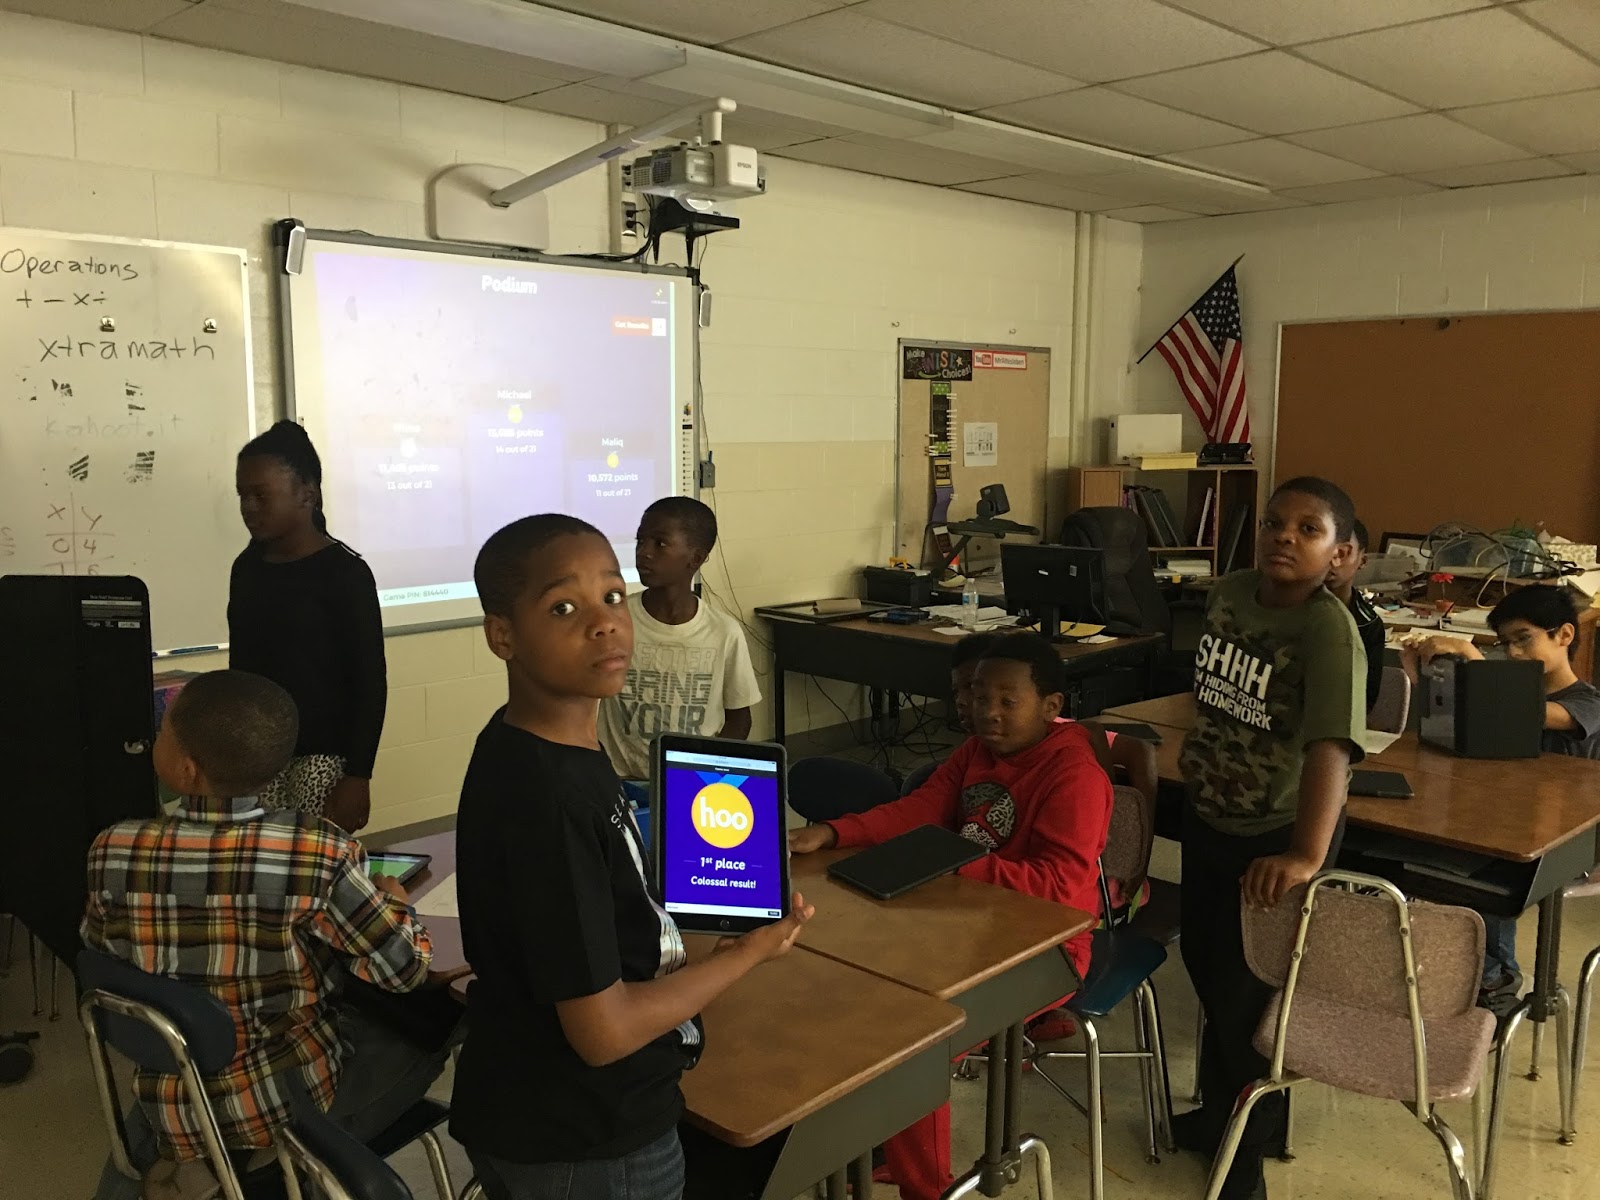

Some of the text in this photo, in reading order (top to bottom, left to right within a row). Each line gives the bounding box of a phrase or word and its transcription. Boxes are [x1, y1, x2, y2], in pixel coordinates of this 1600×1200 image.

[737, 161, 752, 169] EPSON
[1, 248, 139, 281] Operations
[481, 274, 538, 294] Podium
[906, 349, 926, 360] Make
[922, 350, 957, 371] WISE
[941, 366, 972, 379] Choices!
[497, 389, 532, 401] Michael
[505, 446, 519, 454] out
[520, 445, 528, 453] of
[601, 437, 624, 448] Maliq
[397, 481, 412, 490] out
[413, 480, 423, 489] of
[614, 473, 639, 483] points
[602, 489, 615, 497] out
[616, 488, 624, 496] of
[624, 488, 631, 496] 21
[1195, 633, 1273, 700] SHHH
[1205, 673, 1238, 699] HIDING
[1236, 690, 1267, 714] FROM
[1198, 685, 1273, 731] HOMEWORK
[618, 700, 706, 740] YOUR
[699, 796, 748, 831] hoo
[700, 856, 746, 871] 1st place
[690, 875, 757, 889] Colossal result!
